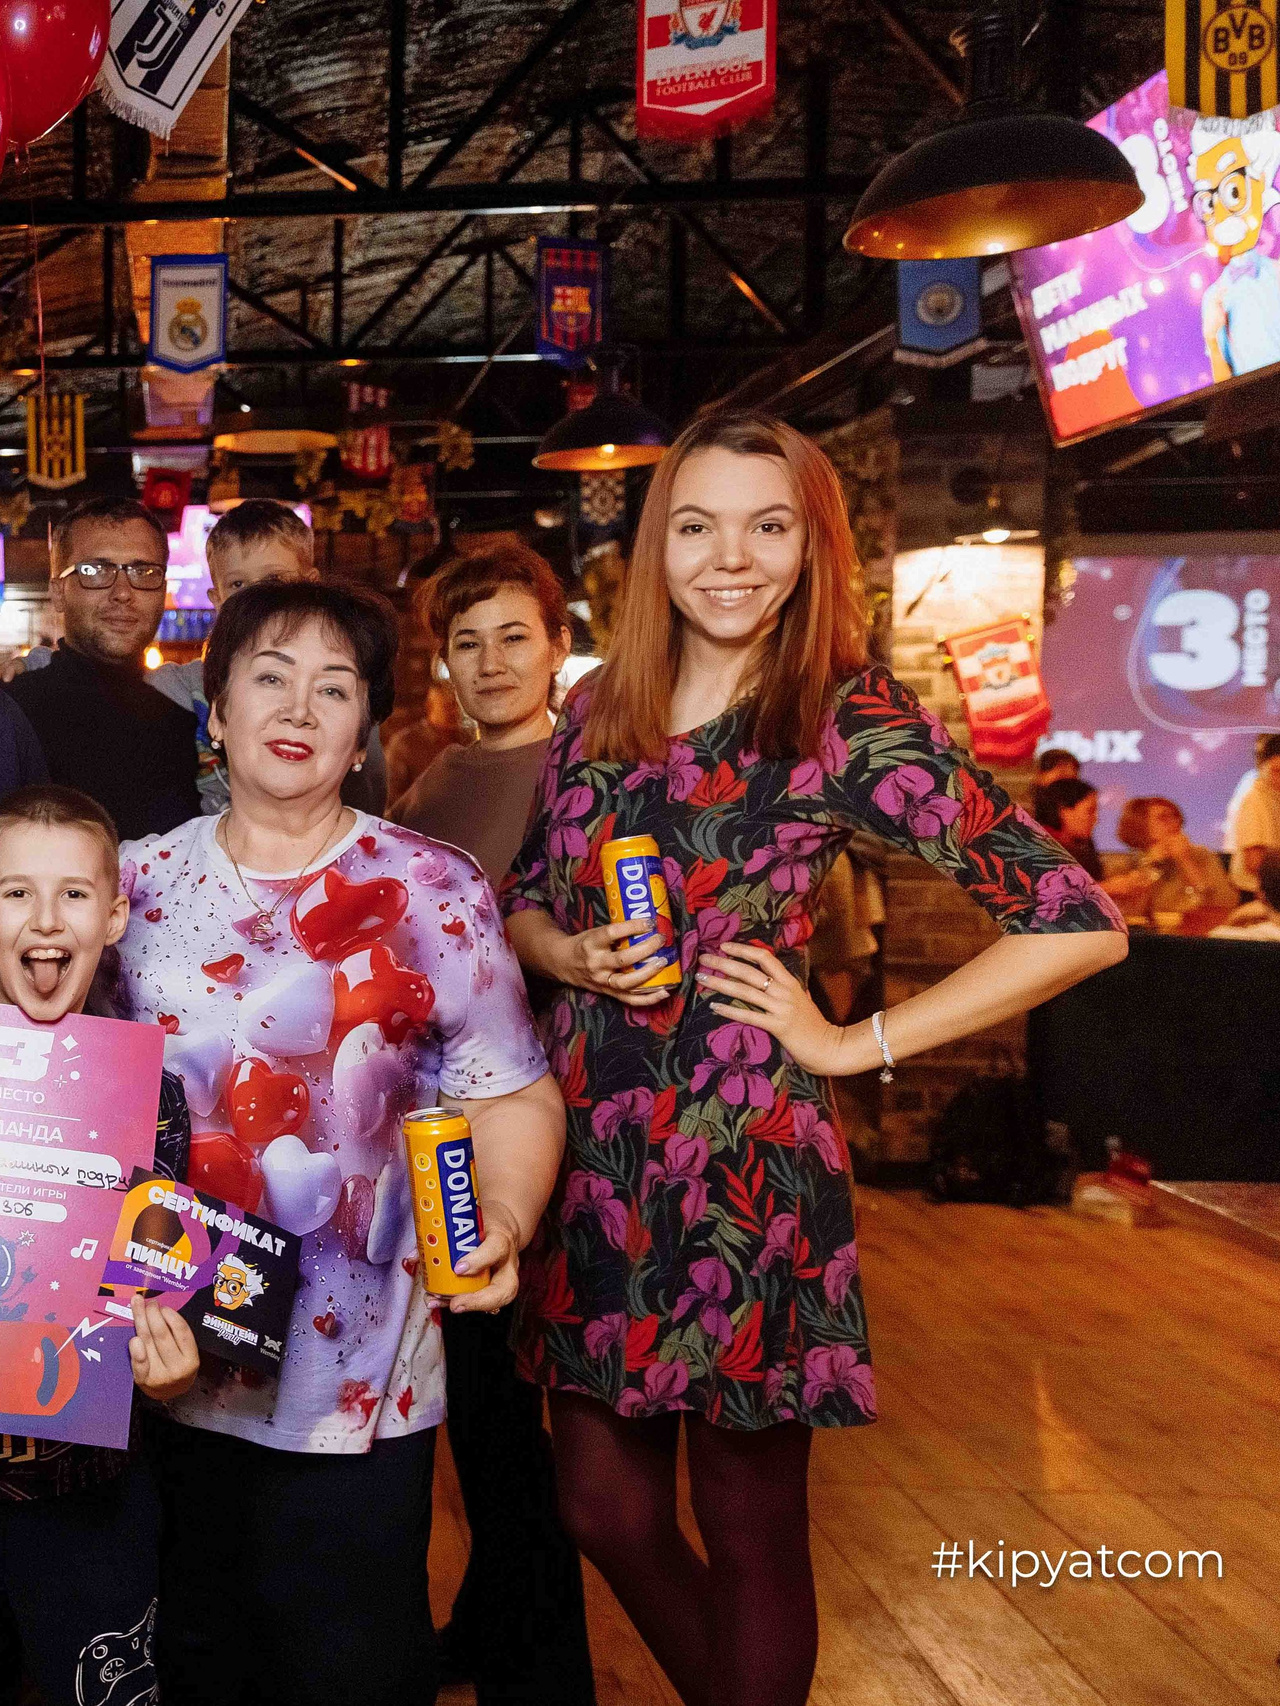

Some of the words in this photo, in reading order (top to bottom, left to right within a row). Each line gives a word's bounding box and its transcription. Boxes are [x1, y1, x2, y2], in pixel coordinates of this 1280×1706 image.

[1213, 13, 1266, 53] BVB
[1228, 51, 1248, 66] 09
[1148, 589, 1240, 691] 3
[33, 1187, 68, 1200] ИГРЫ
[148, 1186, 287, 1257] СЕРТИФИКАТ
[124, 1240, 199, 1281] ПИЦЦУ
